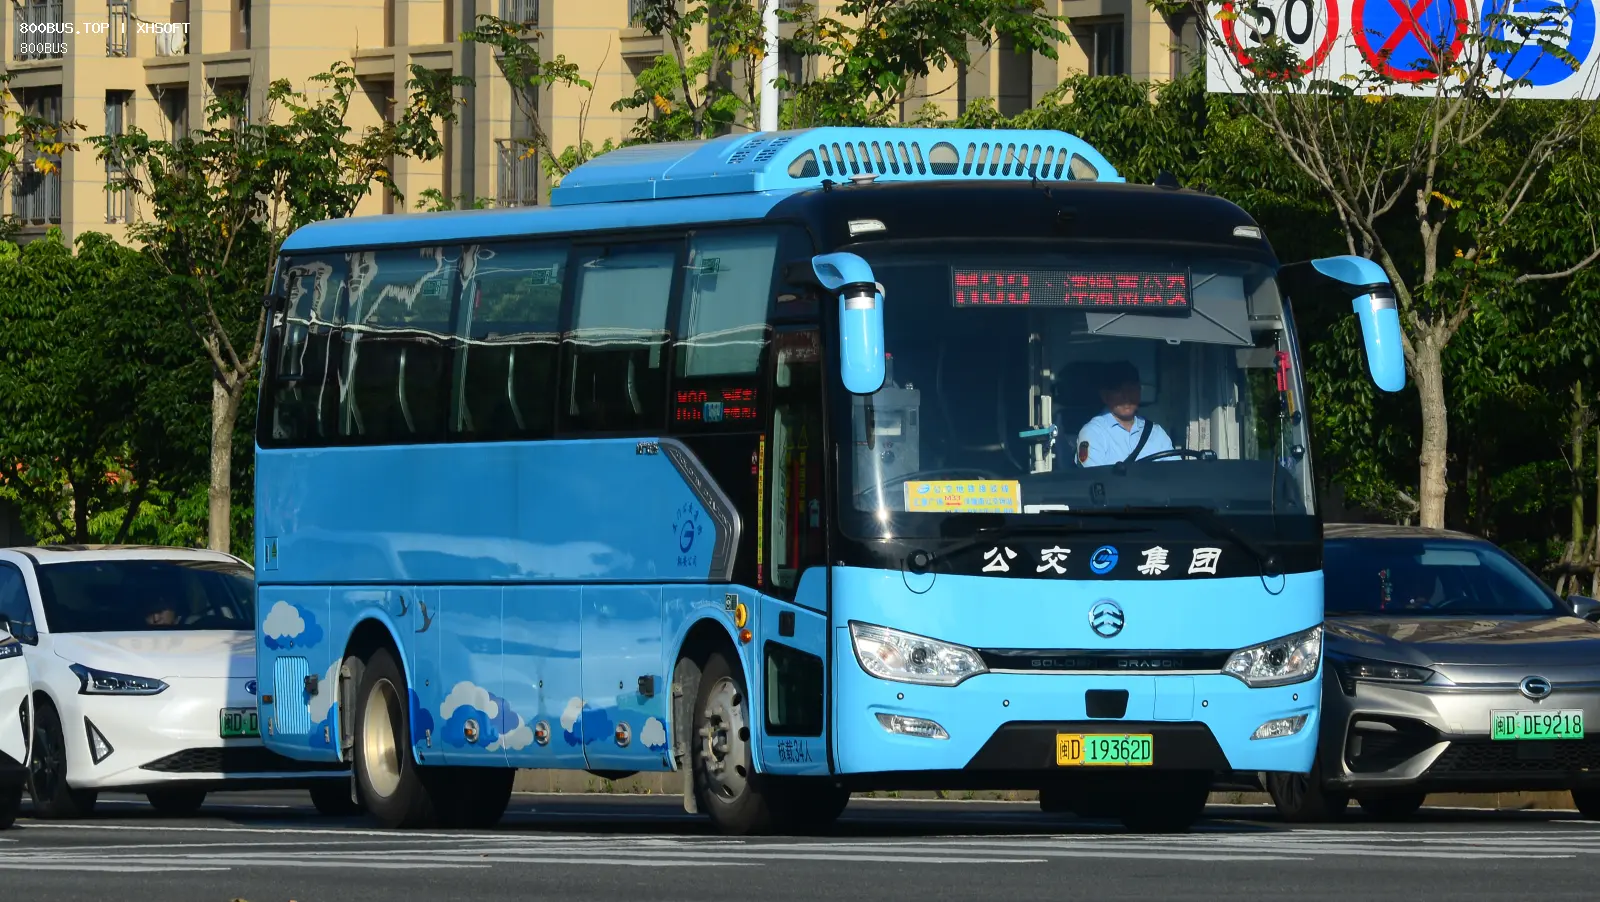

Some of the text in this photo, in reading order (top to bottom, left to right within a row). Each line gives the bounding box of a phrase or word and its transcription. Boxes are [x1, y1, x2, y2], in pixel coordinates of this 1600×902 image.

[1248, 0, 1314, 45] 50
[982, 545, 1222, 575] 公交 集团
[1118, 659, 1183, 668] DRAGON
[1523, 715, 1582, 735] DE9218
[1091, 739, 1151, 760] 19362D
